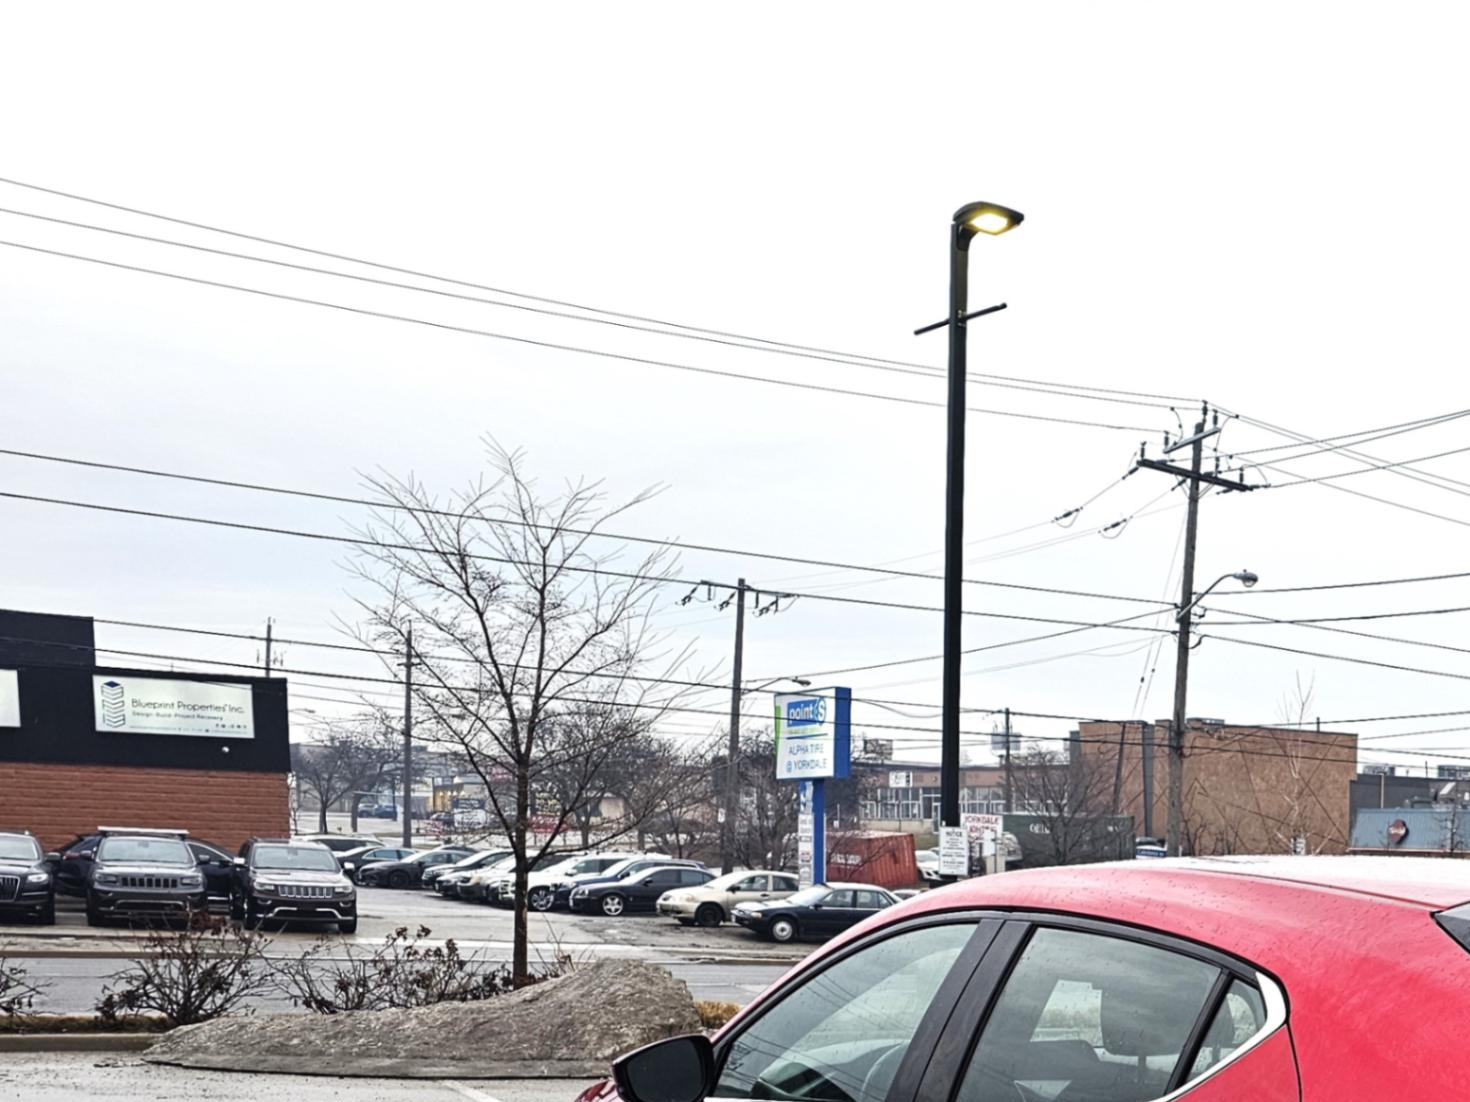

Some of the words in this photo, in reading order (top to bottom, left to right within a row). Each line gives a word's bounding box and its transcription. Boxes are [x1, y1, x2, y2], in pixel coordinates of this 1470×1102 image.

[131, 698, 175, 710] Blueprint
[177, 701, 226, 713] Properties
[229, 704, 246, 714] Inc.
[789, 703, 814, 724] point
[789, 745, 809, 755] ALPHA
[794, 758, 828, 770] YORKDALE
[965, 815, 1000, 825] YORKDALE
